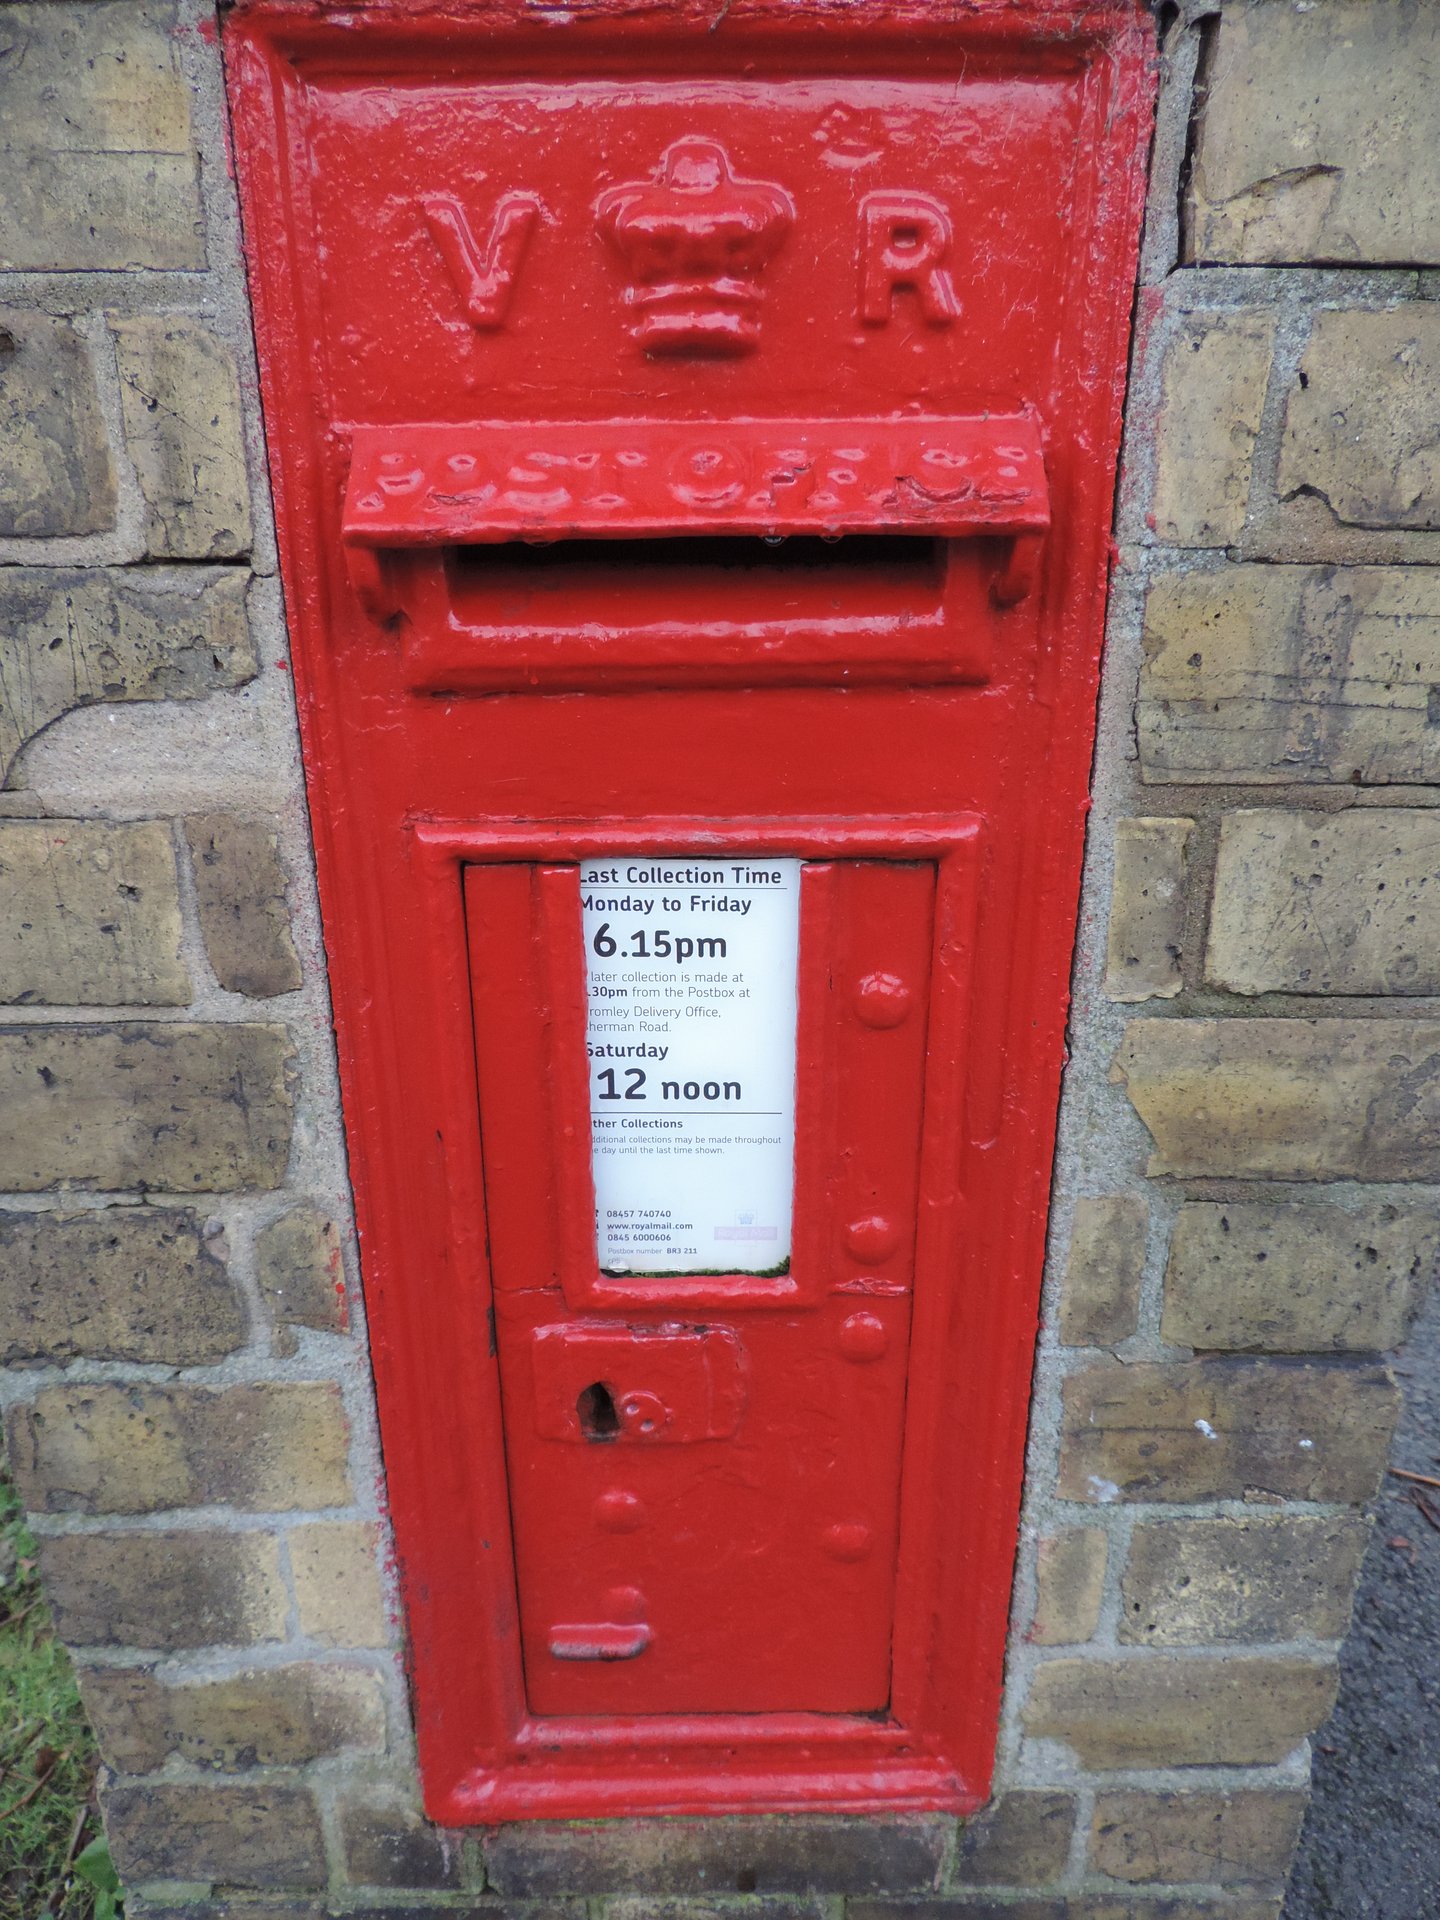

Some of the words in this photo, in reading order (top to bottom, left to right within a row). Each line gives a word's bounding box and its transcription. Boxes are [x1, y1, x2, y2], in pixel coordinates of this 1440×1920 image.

[422, 191, 540, 332] V
[857, 190, 962, 329] R
[627, 866, 724, 884] Collection
[731, 867, 782, 884] Time
[662, 897, 681, 912] to
[690, 895, 752, 916] Friday
[593, 922, 727, 964] 6.15pm
[591, 971, 617, 982] later
[621, 971, 677, 983] collection
[681, 972, 690, 983] is
[694, 972, 728, 983] made
[732, 972, 744, 983] at
[587, 986, 628, 999] .30pm
[632, 986, 660, 998] from
[665, 987, 684, 998] the
[688, 986, 735, 998] Postbox
[738, 987, 751, 998] at
[590, 1006, 630, 1019] romley
[634, 1005, 681, 1019] Delivery
[685, 1006, 721, 1019] Office,
[587, 1021, 635, 1032] herman
[639, 1021, 672, 1032] Road.
[597, 1067, 647, 1100] 12
[661, 1081, 741, 1100] noon
[593, 1118, 617, 1129] ther
[621, 1118, 683, 1129] Collections
[592, 1135, 626, 1144] dditional
[629, 1135, 672, 1144] collections
[675, 1137, 693, 1146] may
[695, 1136, 706, 1144] be
[708, 1136, 732, 1144] made
[734, 1136, 782, 1146] throughout
[601, 1146, 616, 1155] day
[619, 1146, 637, 1154] until
[640, 1146, 654, 1154] the
[656, 1146, 671, 1154] last
[674, 1146, 693, 1154] time
[695, 1146, 725, 1154] shown.
[606, 1210, 635, 1218] 08457
[638, 1210, 672, 1218] 740740
[607, 1222, 693, 1231] www.royalmail.com
[607, 1233, 630, 1242] 0845
[633, 1233, 672, 1242] 6000606
[608, 1247, 634, 1255] Postbox
[636, 1247, 663, 1255] number
